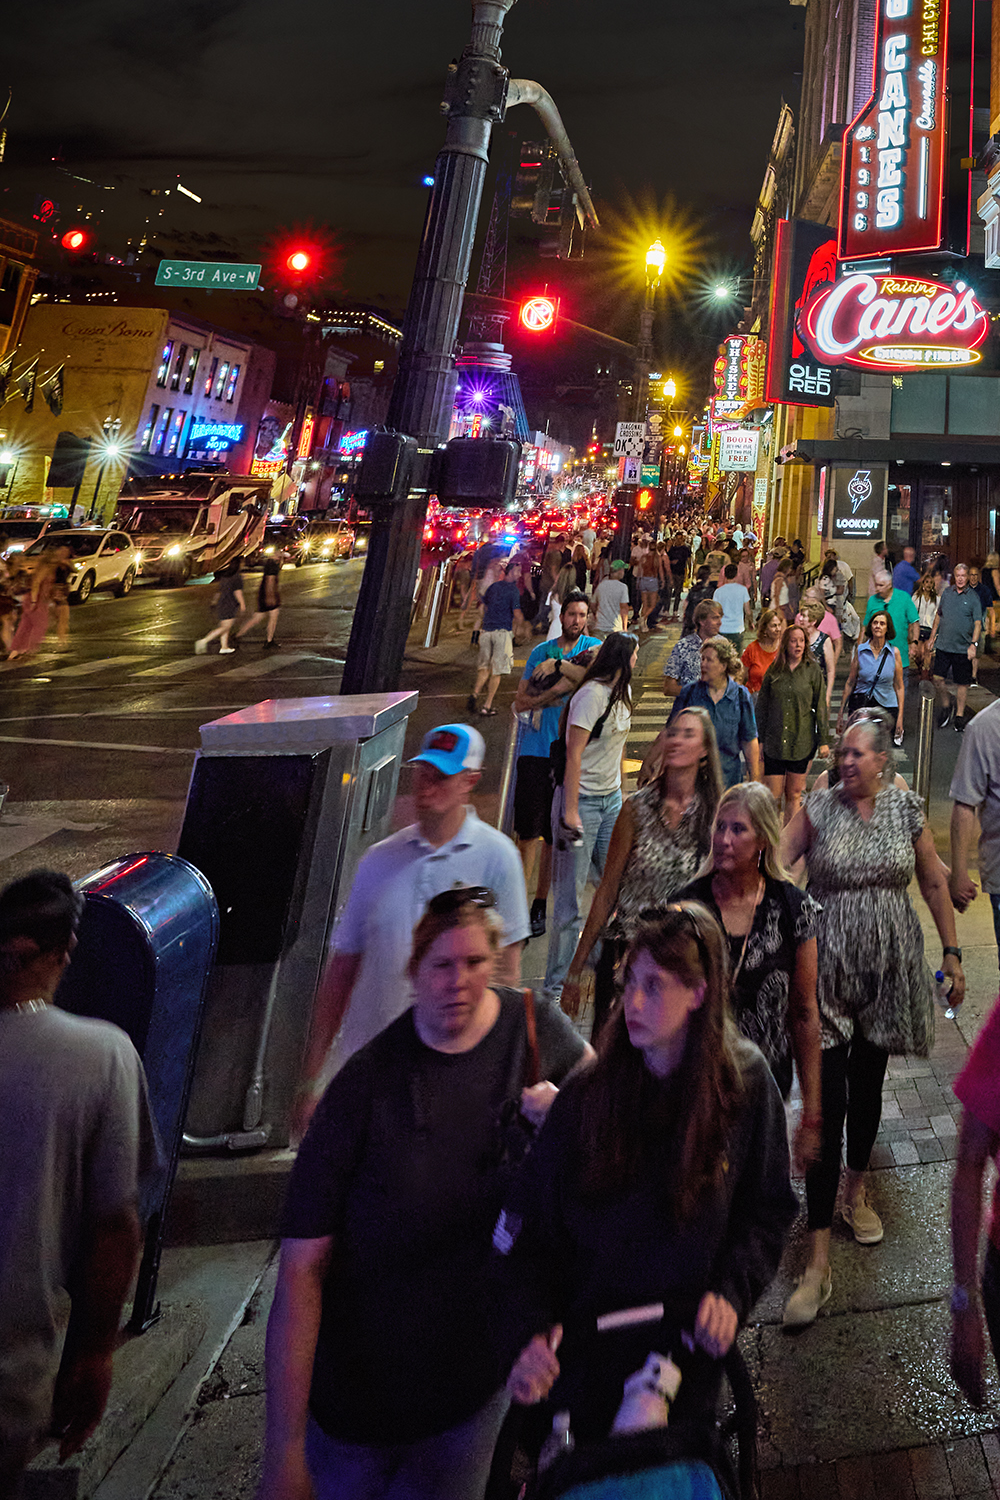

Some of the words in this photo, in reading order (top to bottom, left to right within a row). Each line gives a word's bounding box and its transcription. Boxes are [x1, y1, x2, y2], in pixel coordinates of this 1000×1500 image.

[916, 59, 936, 130] Craveable
[876, 34, 907, 228] CANES
[854, 147, 870, 230] 1996
[880, 279, 938, 297] Raising
[815, 274, 986, 355] Cane's
[62, 320, 105, 336] Casa
[107, 321, 154, 338] Bona
[726, 340, 743, 400] WHISKEY
[789, 364, 832, 382] OLE
[788, 379, 831, 396] RED
[205, 441, 229, 451] MOJO
[615, 439, 627, 452] OK
[726, 436, 754, 444] BOOTS
[836, 518, 880, 529] LOOKOUT
